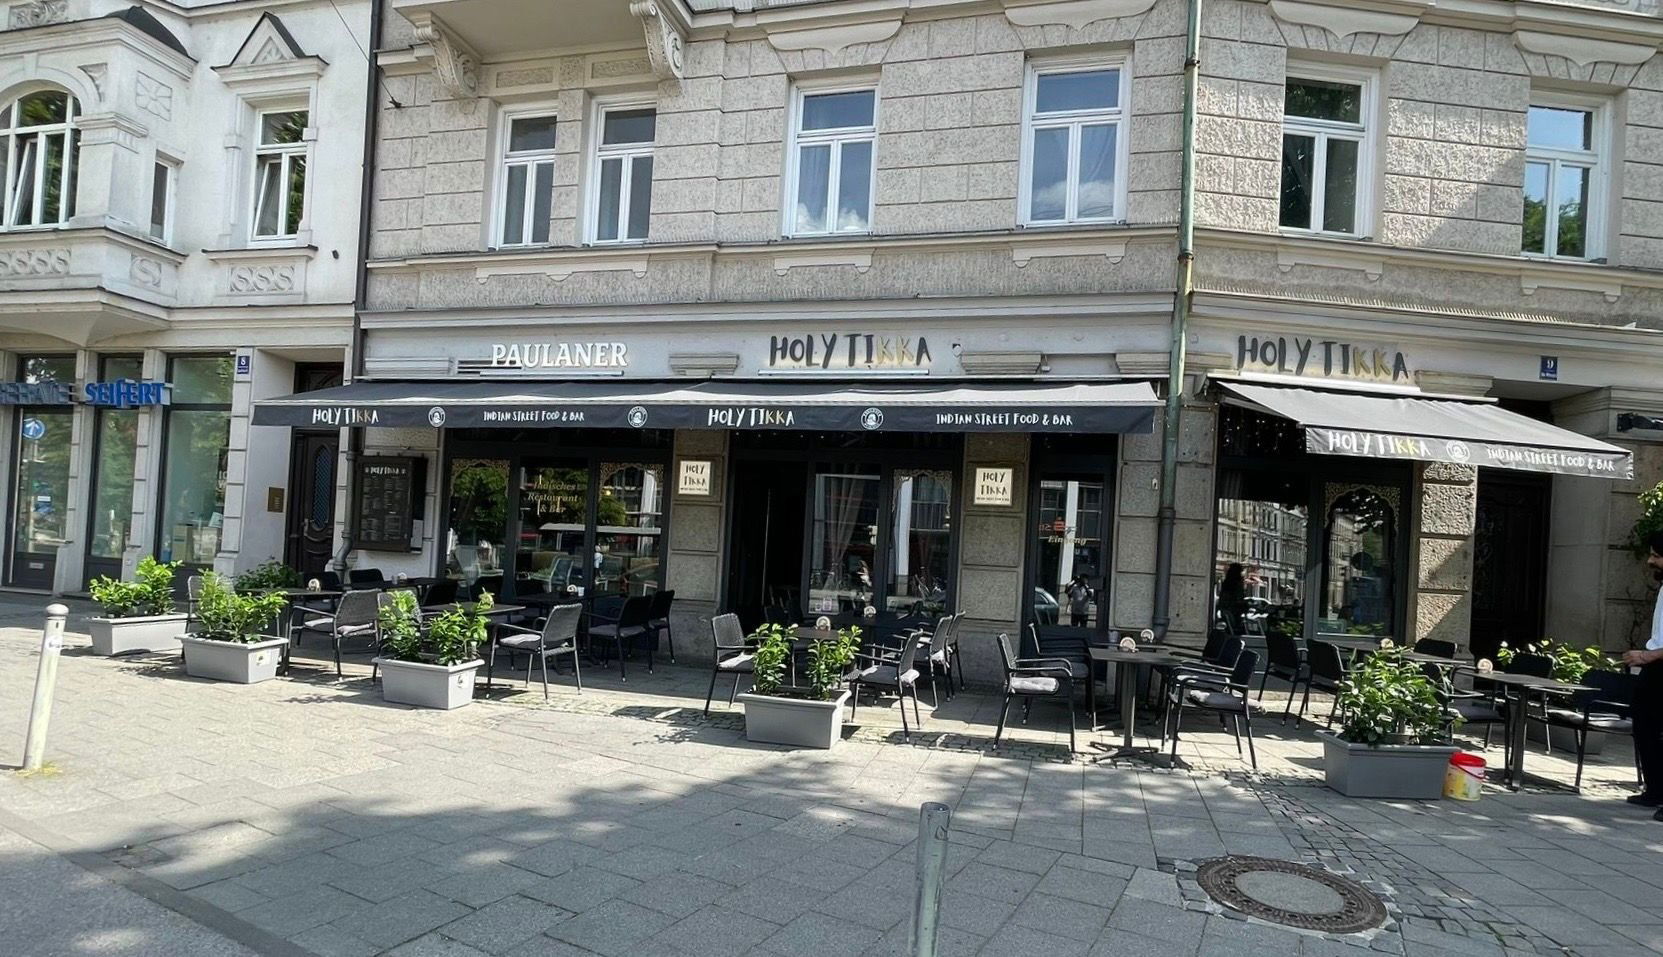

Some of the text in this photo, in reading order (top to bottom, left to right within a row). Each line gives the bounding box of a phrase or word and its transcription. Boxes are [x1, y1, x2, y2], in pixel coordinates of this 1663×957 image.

[490, 342, 628, 368] PAULANER
[769, 333, 931, 369] HOLY TIKKA
[1237, 335, 1408, 381] HOLY TIKKA
[312, 407, 380, 425] HOLY TIKKA
[483, 410, 585, 422] INDIAN STREET FOOD & BAR
[707, 407, 795, 428] HOLY TIKKA
[936, 412, 1073, 426] INDIAN STREET FOOD & BAR
[1328, 431, 1371, 455] HOLY
[1374, 434, 1431, 457] TIKKA
[685, 464, 705, 475] HOLY
[1488, 448, 1616, 472] INDIAN STREET FOOD & BAR
[982, 471, 1006, 483] HOLY
[980, 484, 1008, 496] TIKKA
